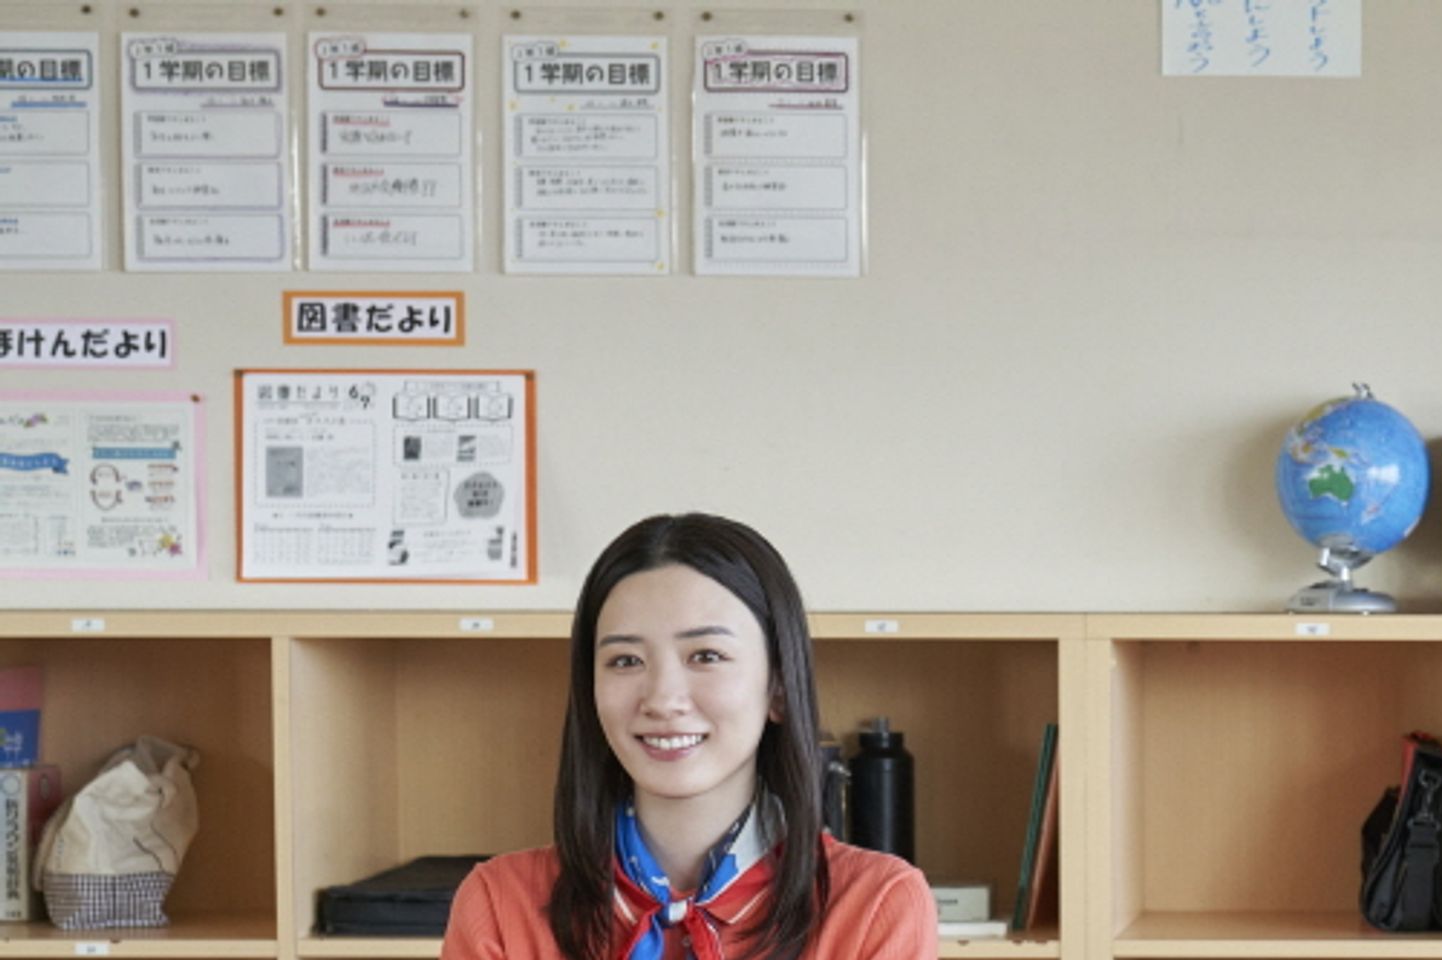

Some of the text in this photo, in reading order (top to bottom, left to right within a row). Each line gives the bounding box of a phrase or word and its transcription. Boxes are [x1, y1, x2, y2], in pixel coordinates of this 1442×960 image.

[143, 60, 271, 82] 1学期の目標
[329, 60, 454, 82] 1学期の目標
[524, 63, 650, 85] 1学期の目標
[713, 61, 838, 84] 1学期の目標
[297, 302, 451, 334] 図書だより
